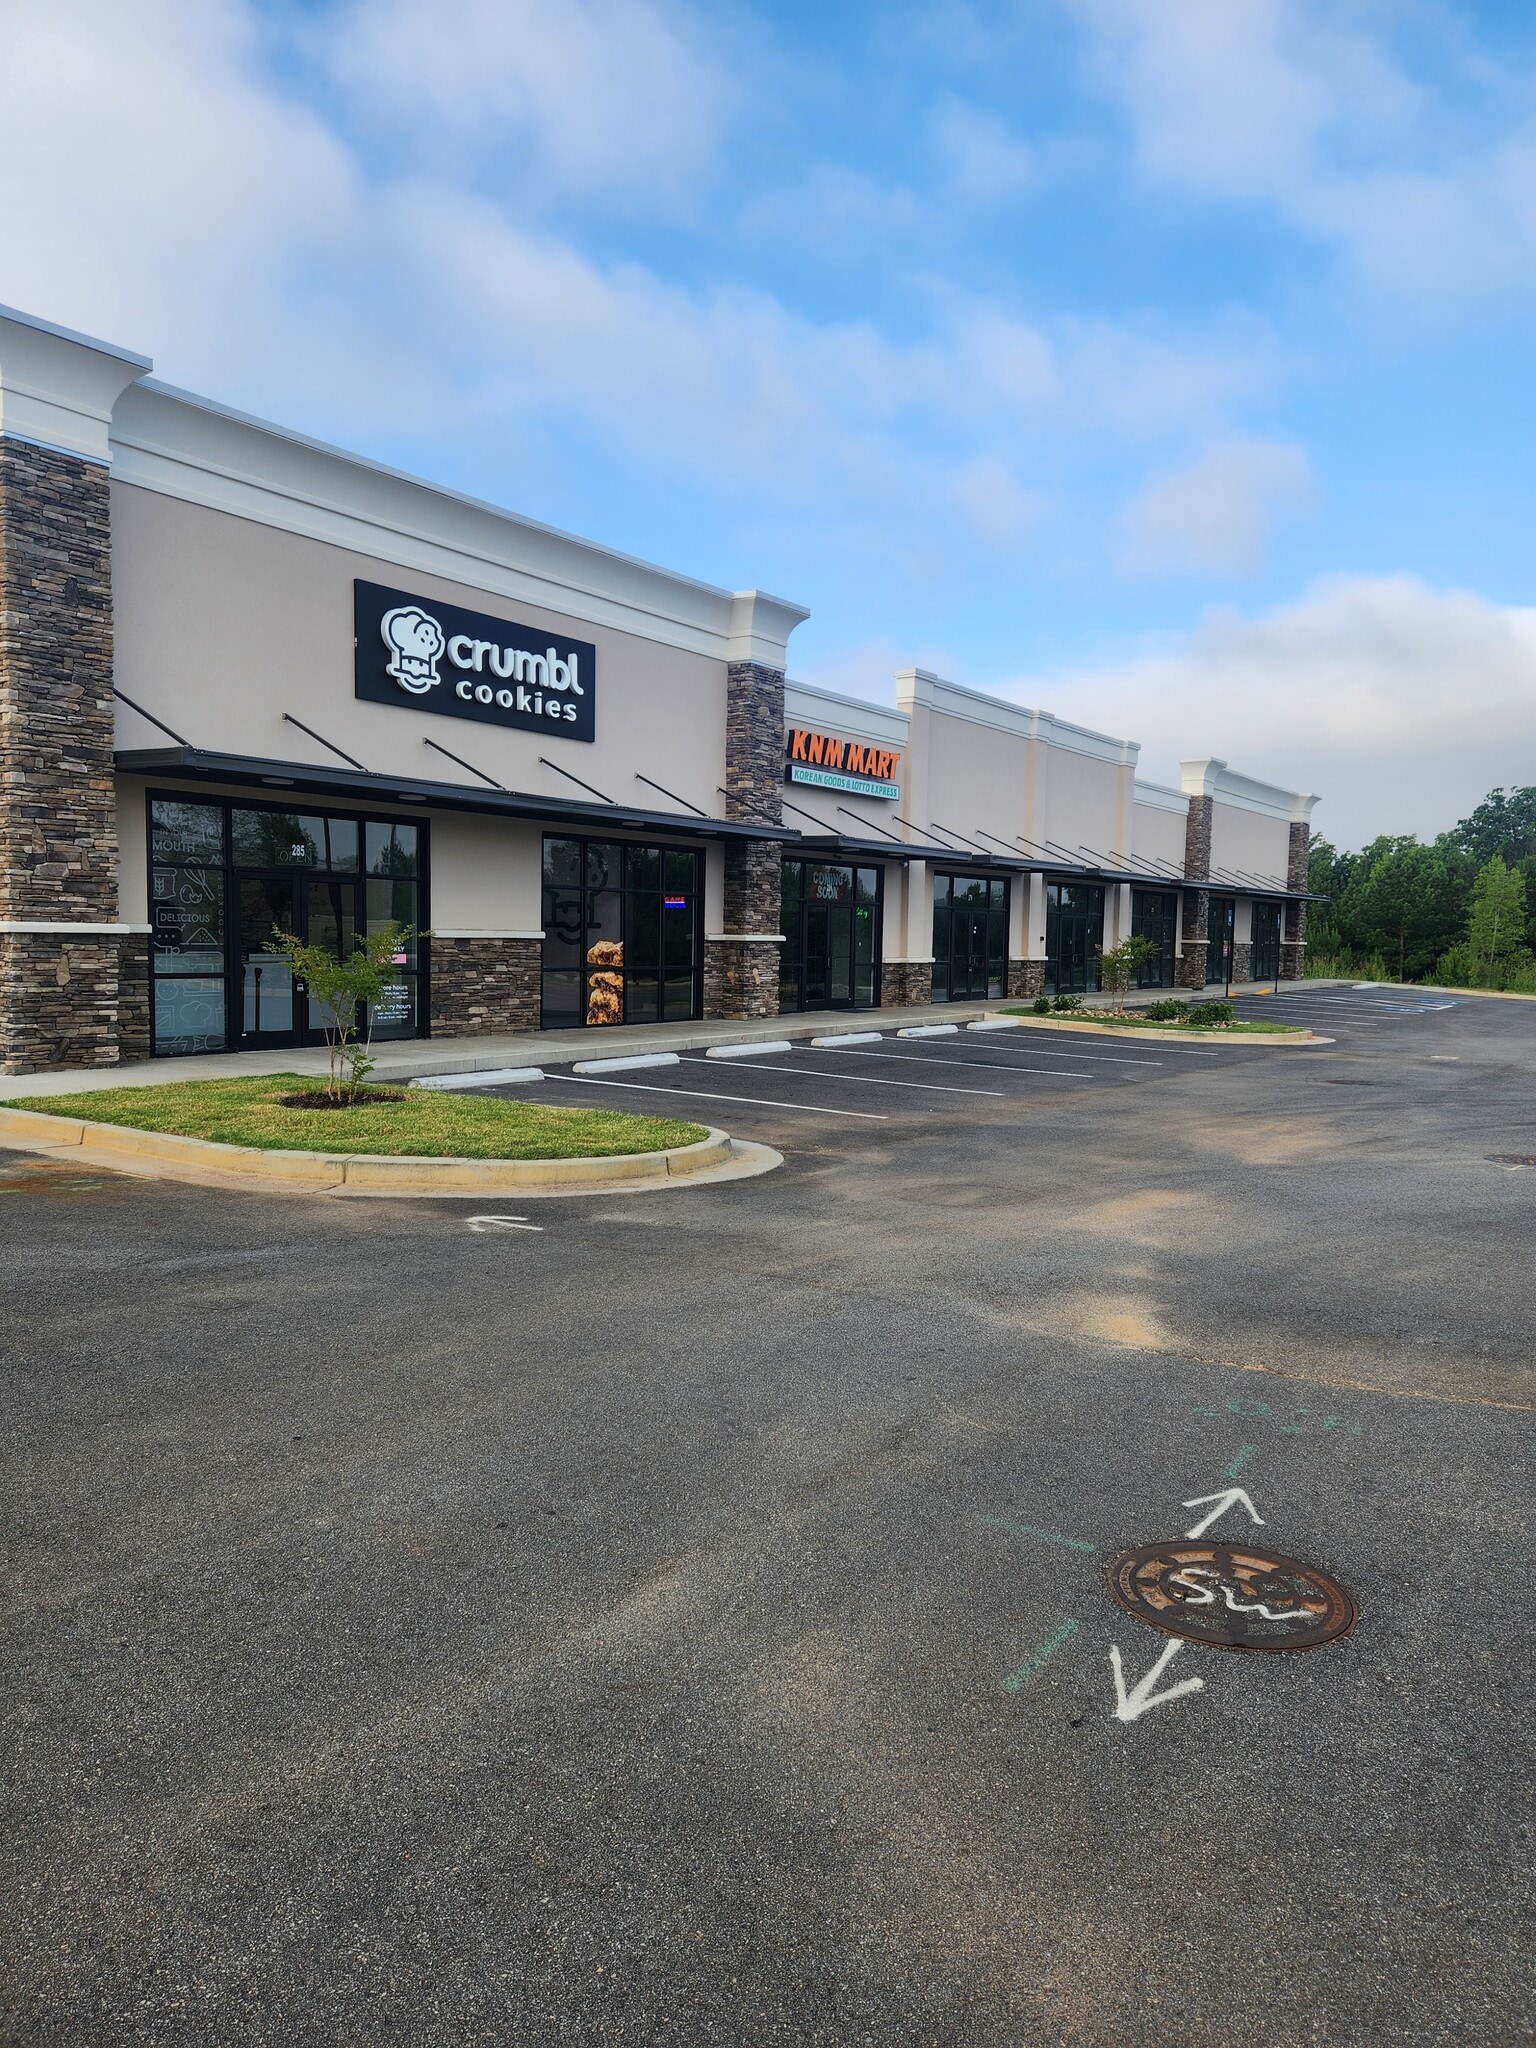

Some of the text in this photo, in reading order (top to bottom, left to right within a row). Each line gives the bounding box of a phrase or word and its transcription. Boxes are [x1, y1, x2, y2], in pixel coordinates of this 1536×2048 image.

[447, 635, 585, 696] crumbl
[455, 681, 578, 722] cookies
[787, 729, 900, 780] KNM MART
[794, 769, 822, 784] KOREAN
[823, 776, 845, 788] GOODS
[852, 781, 870, 793] LOTTO
[871, 786, 897, 797] EXPRESS
[152, 839, 196, 852] MOUTH
[291, 844, 305, 857] 285
[813, 871, 844, 886] COMING
[816, 885, 838, 900] SOON
[160, 913, 211, 923] DELICIOUS
